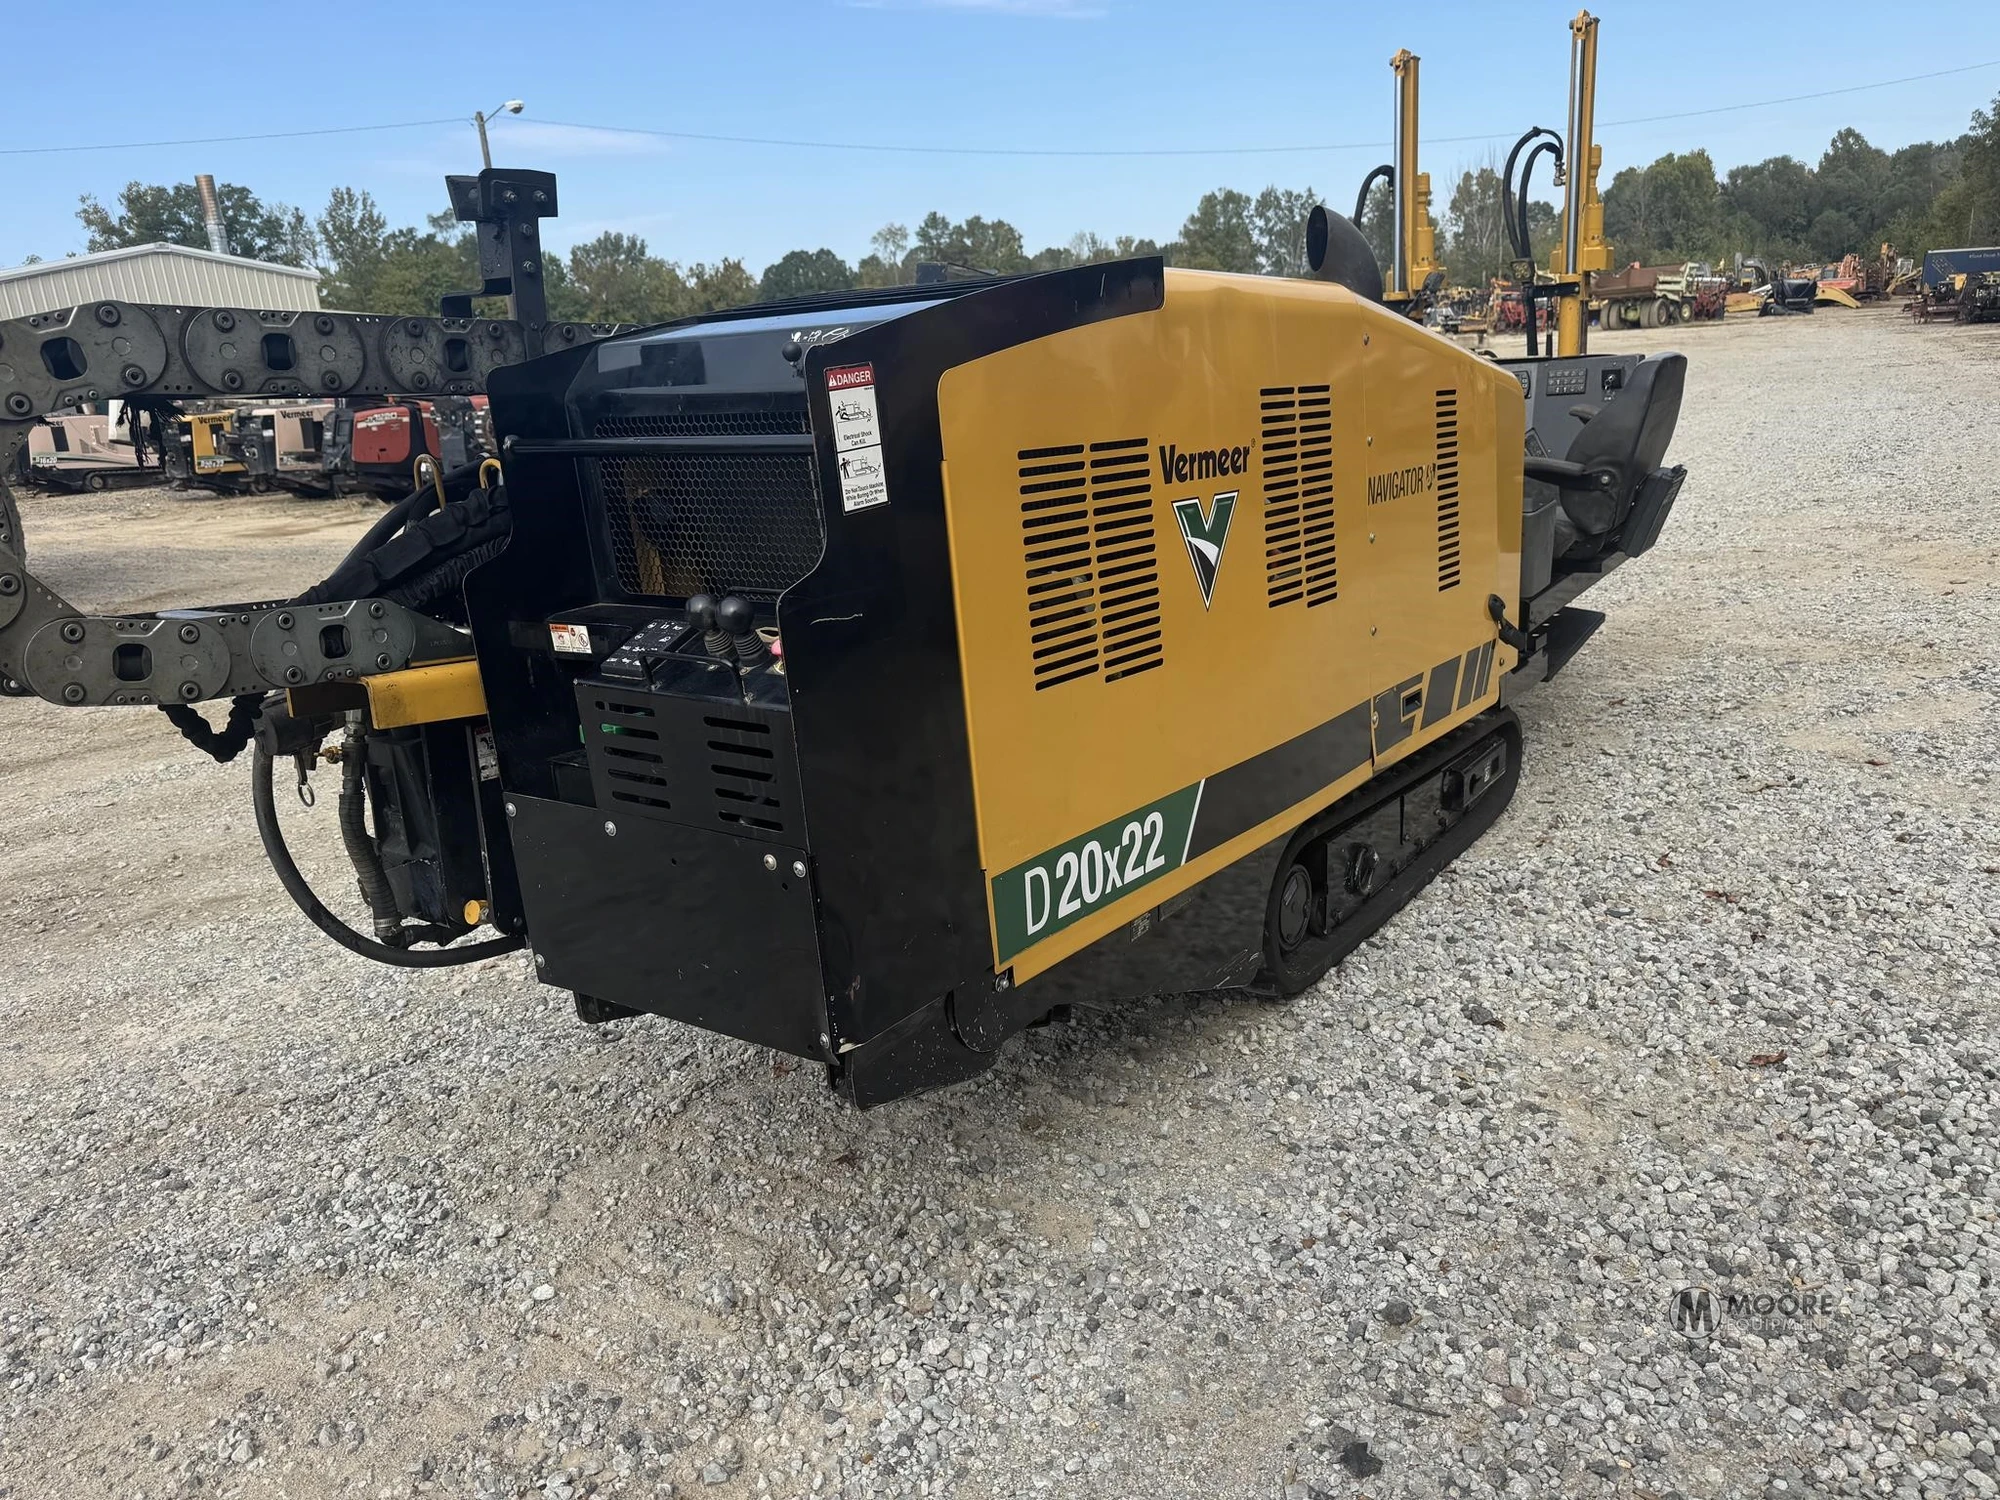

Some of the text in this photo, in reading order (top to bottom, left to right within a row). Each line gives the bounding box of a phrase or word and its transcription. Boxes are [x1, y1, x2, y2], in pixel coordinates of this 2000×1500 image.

[836, 370, 872, 386] DANGER
[280, 409, 314, 419] Vermeer
[843, 430, 872, 441] Electrical Shock
[1158, 444, 1250, 485] Vermeer
[1367, 465, 1424, 507] NAVIGATOR
